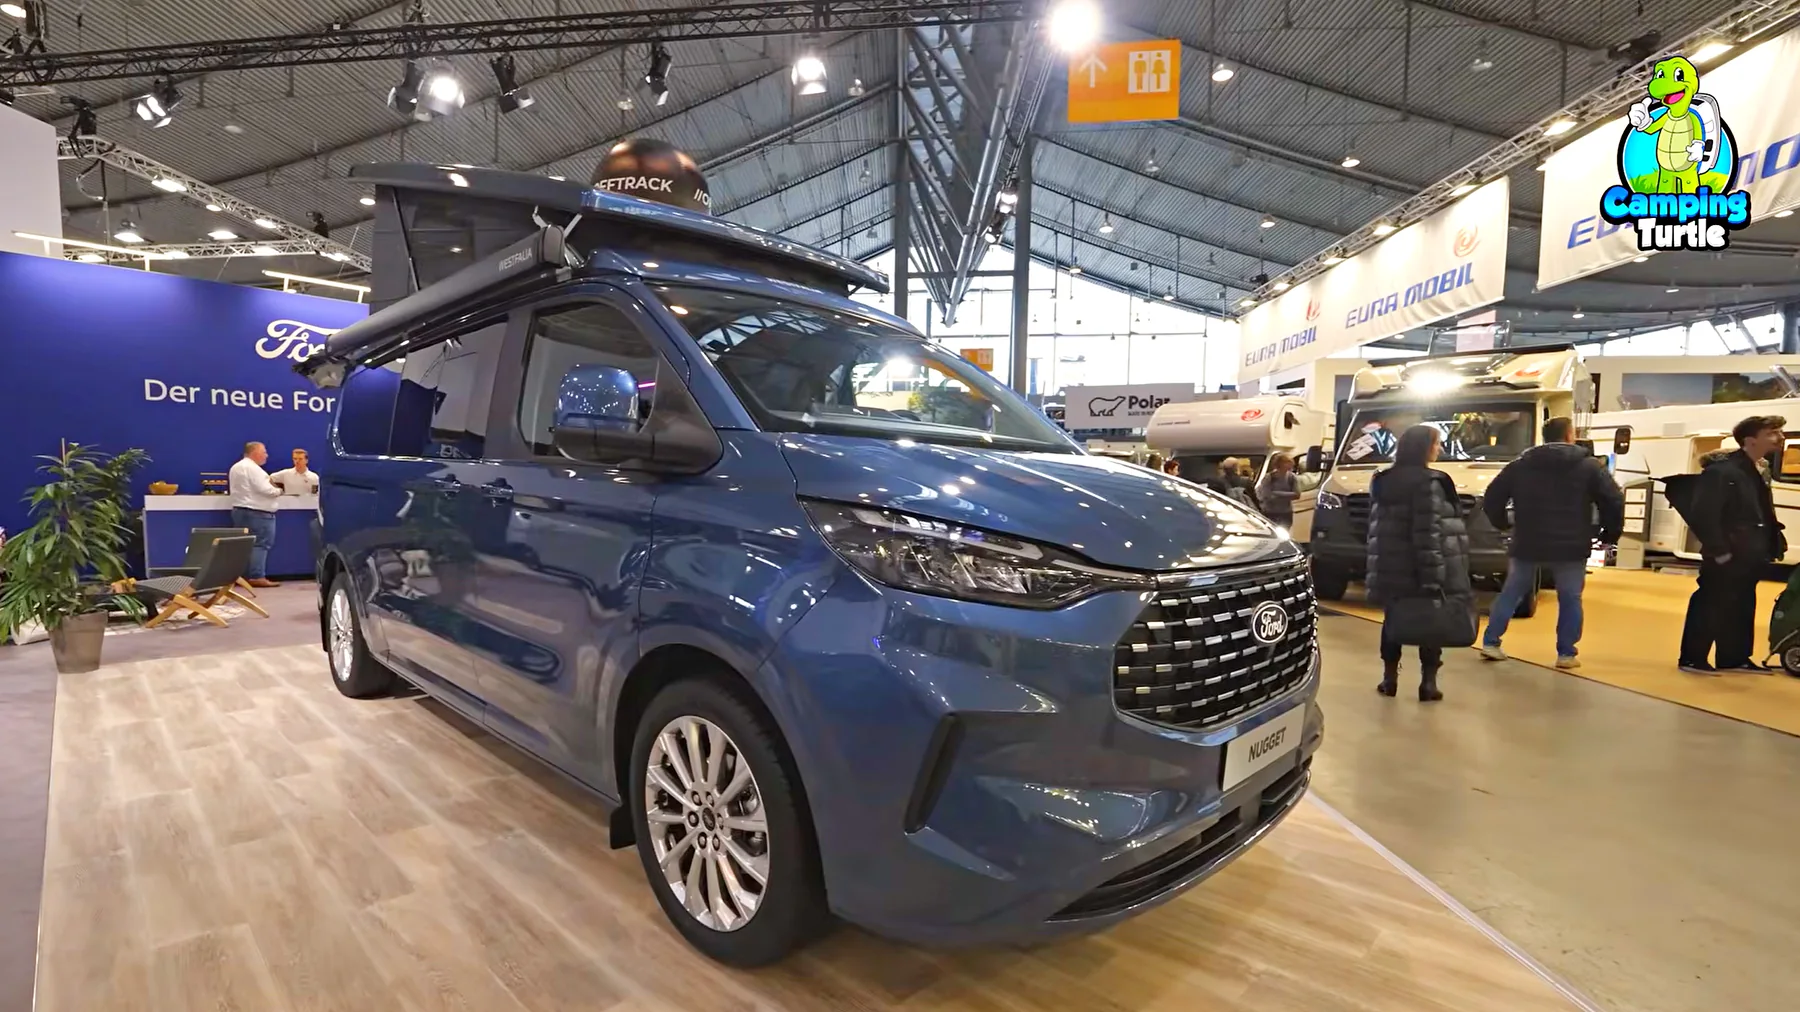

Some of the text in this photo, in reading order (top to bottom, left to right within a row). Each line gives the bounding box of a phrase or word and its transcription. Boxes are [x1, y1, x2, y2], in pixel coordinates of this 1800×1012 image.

[1345, 262, 1474, 329] EURA MOBIL
[1245, 325, 1317, 367] EURA MOBIL
[144, 378, 201, 404] Der
[211, 388, 284, 409] neue
[1260, 610, 1285, 638] Ford
[1248, 727, 1287, 763] NUGGET
